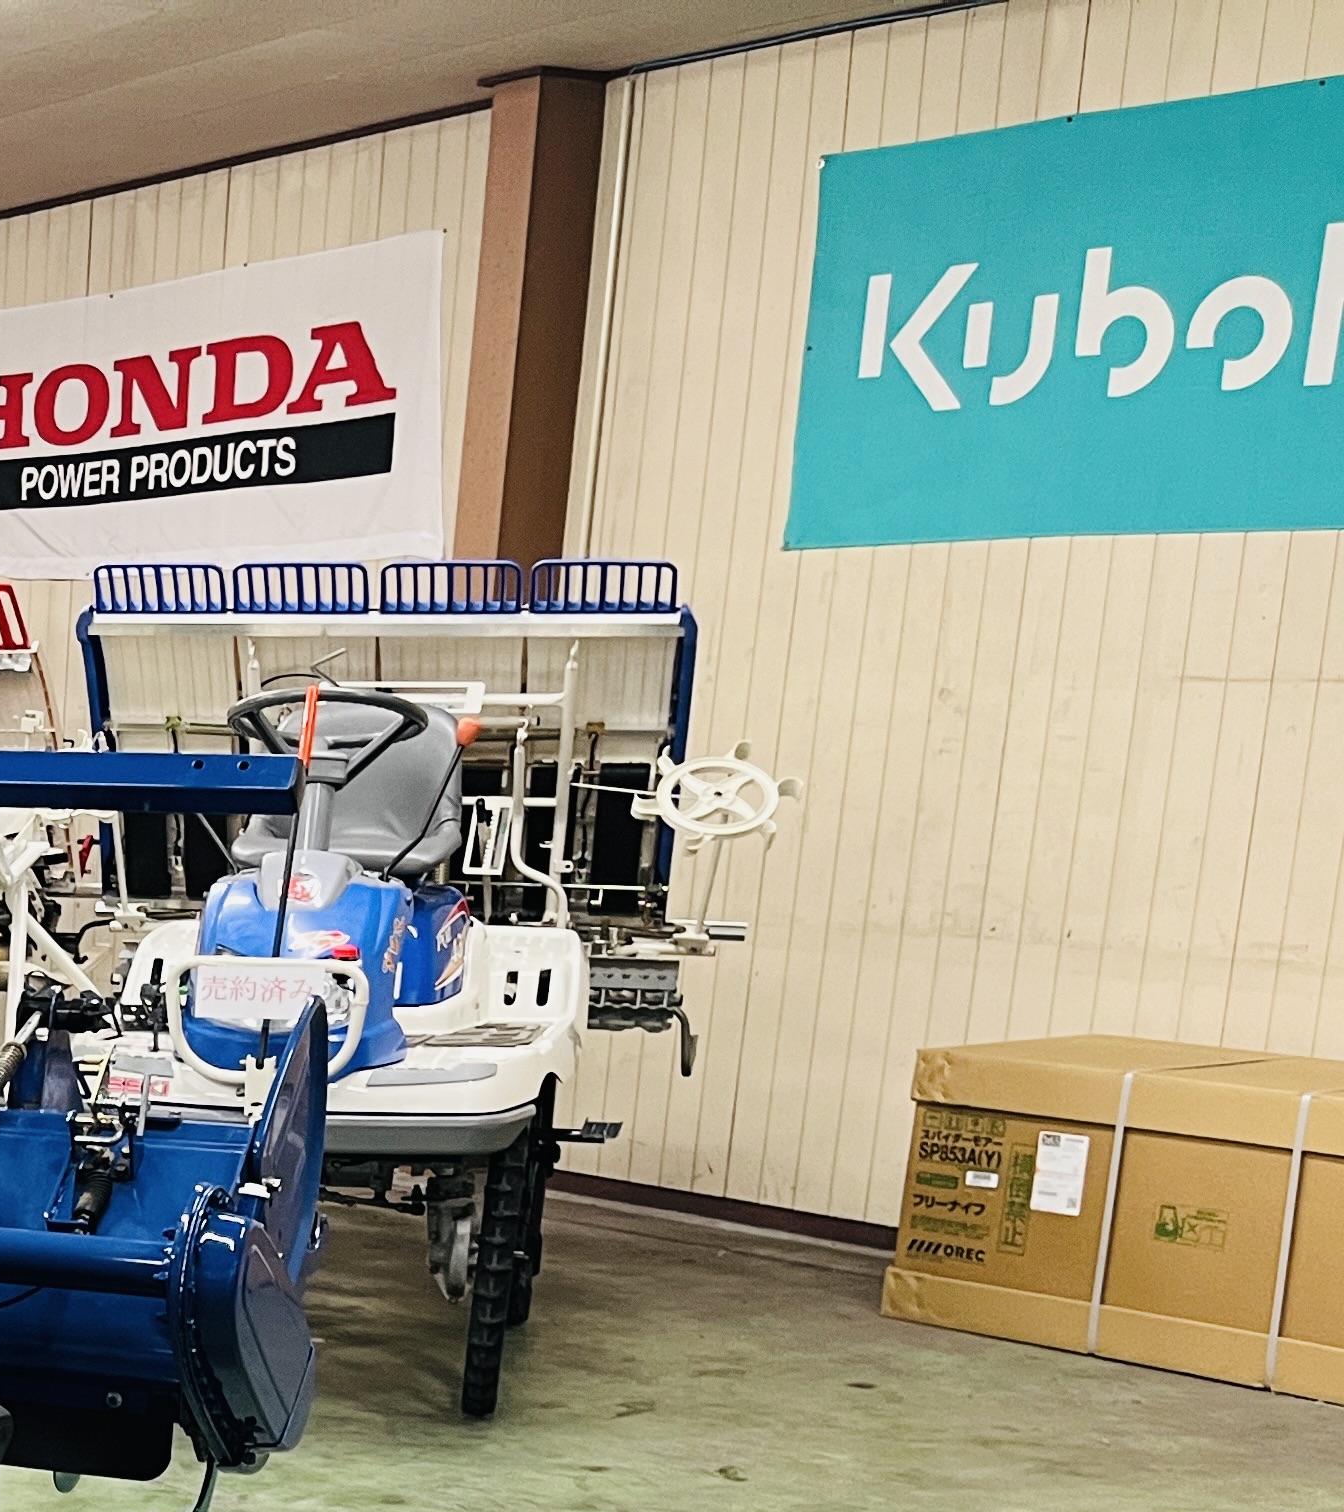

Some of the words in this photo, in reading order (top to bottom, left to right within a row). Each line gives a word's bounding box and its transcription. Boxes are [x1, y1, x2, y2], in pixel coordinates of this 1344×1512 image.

[20, 460, 120, 501] POWER
[129, 436, 297, 492] PRODUCTS
[201, 974, 313, 1004] 売約済み
[943, 1243, 986, 1263] OREC
